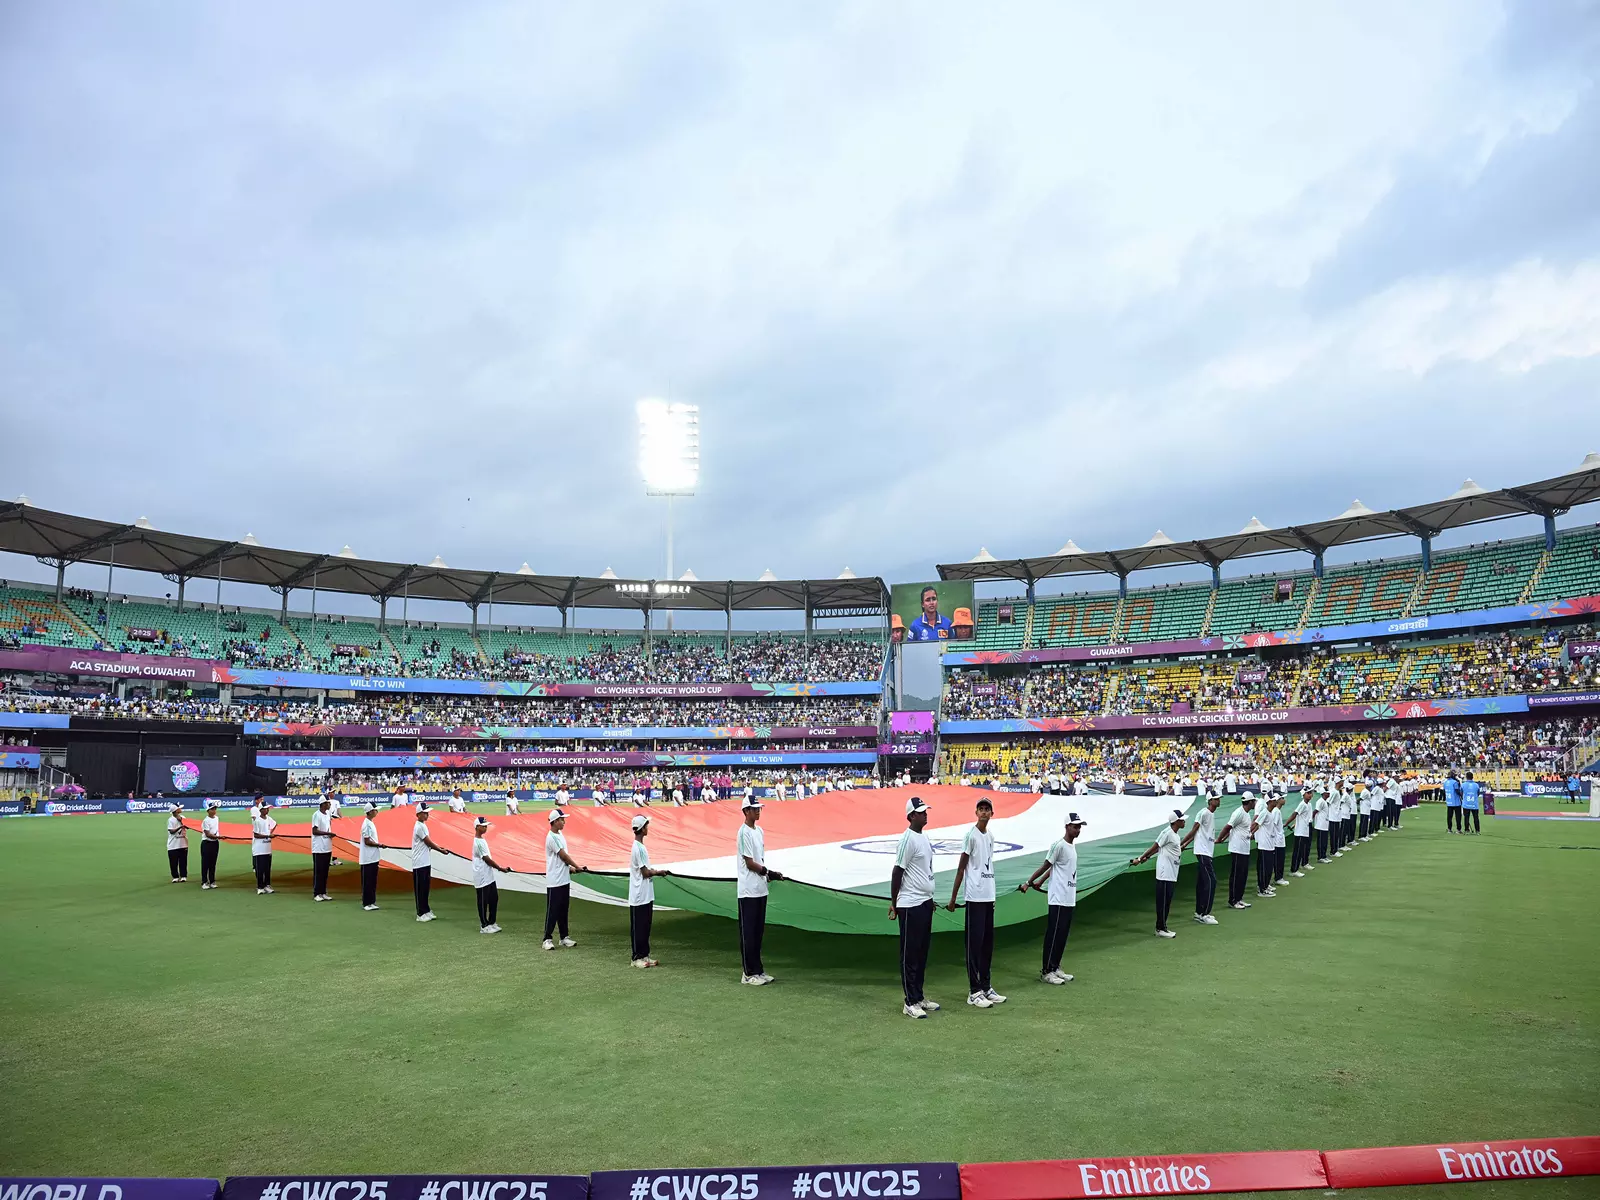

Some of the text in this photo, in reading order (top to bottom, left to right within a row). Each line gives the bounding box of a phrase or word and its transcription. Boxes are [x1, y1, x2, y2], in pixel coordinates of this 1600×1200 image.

[1090, 647, 1133, 656] GUWAHATI
[70, 661, 195, 677] ACA STADIUM, GUWAHATI
[350, 678, 405, 689] WILL TO WIN
[707, 686, 722, 694] CUP
[1142, 712, 1288, 726] ICC WOMEN'S CRICKET WORLD CUP
[379, 727, 420, 735] GUWAHATI
[5, 805, 19, 813] Good
[1436, 1144, 1563, 1180] Emirates
[629, 1169, 921, 1200] #CWC25 #CWC25
[1078, 1162, 1211, 1196] Emirates
[259, 1181, 548, 1200] #CWC25 #CWC25
